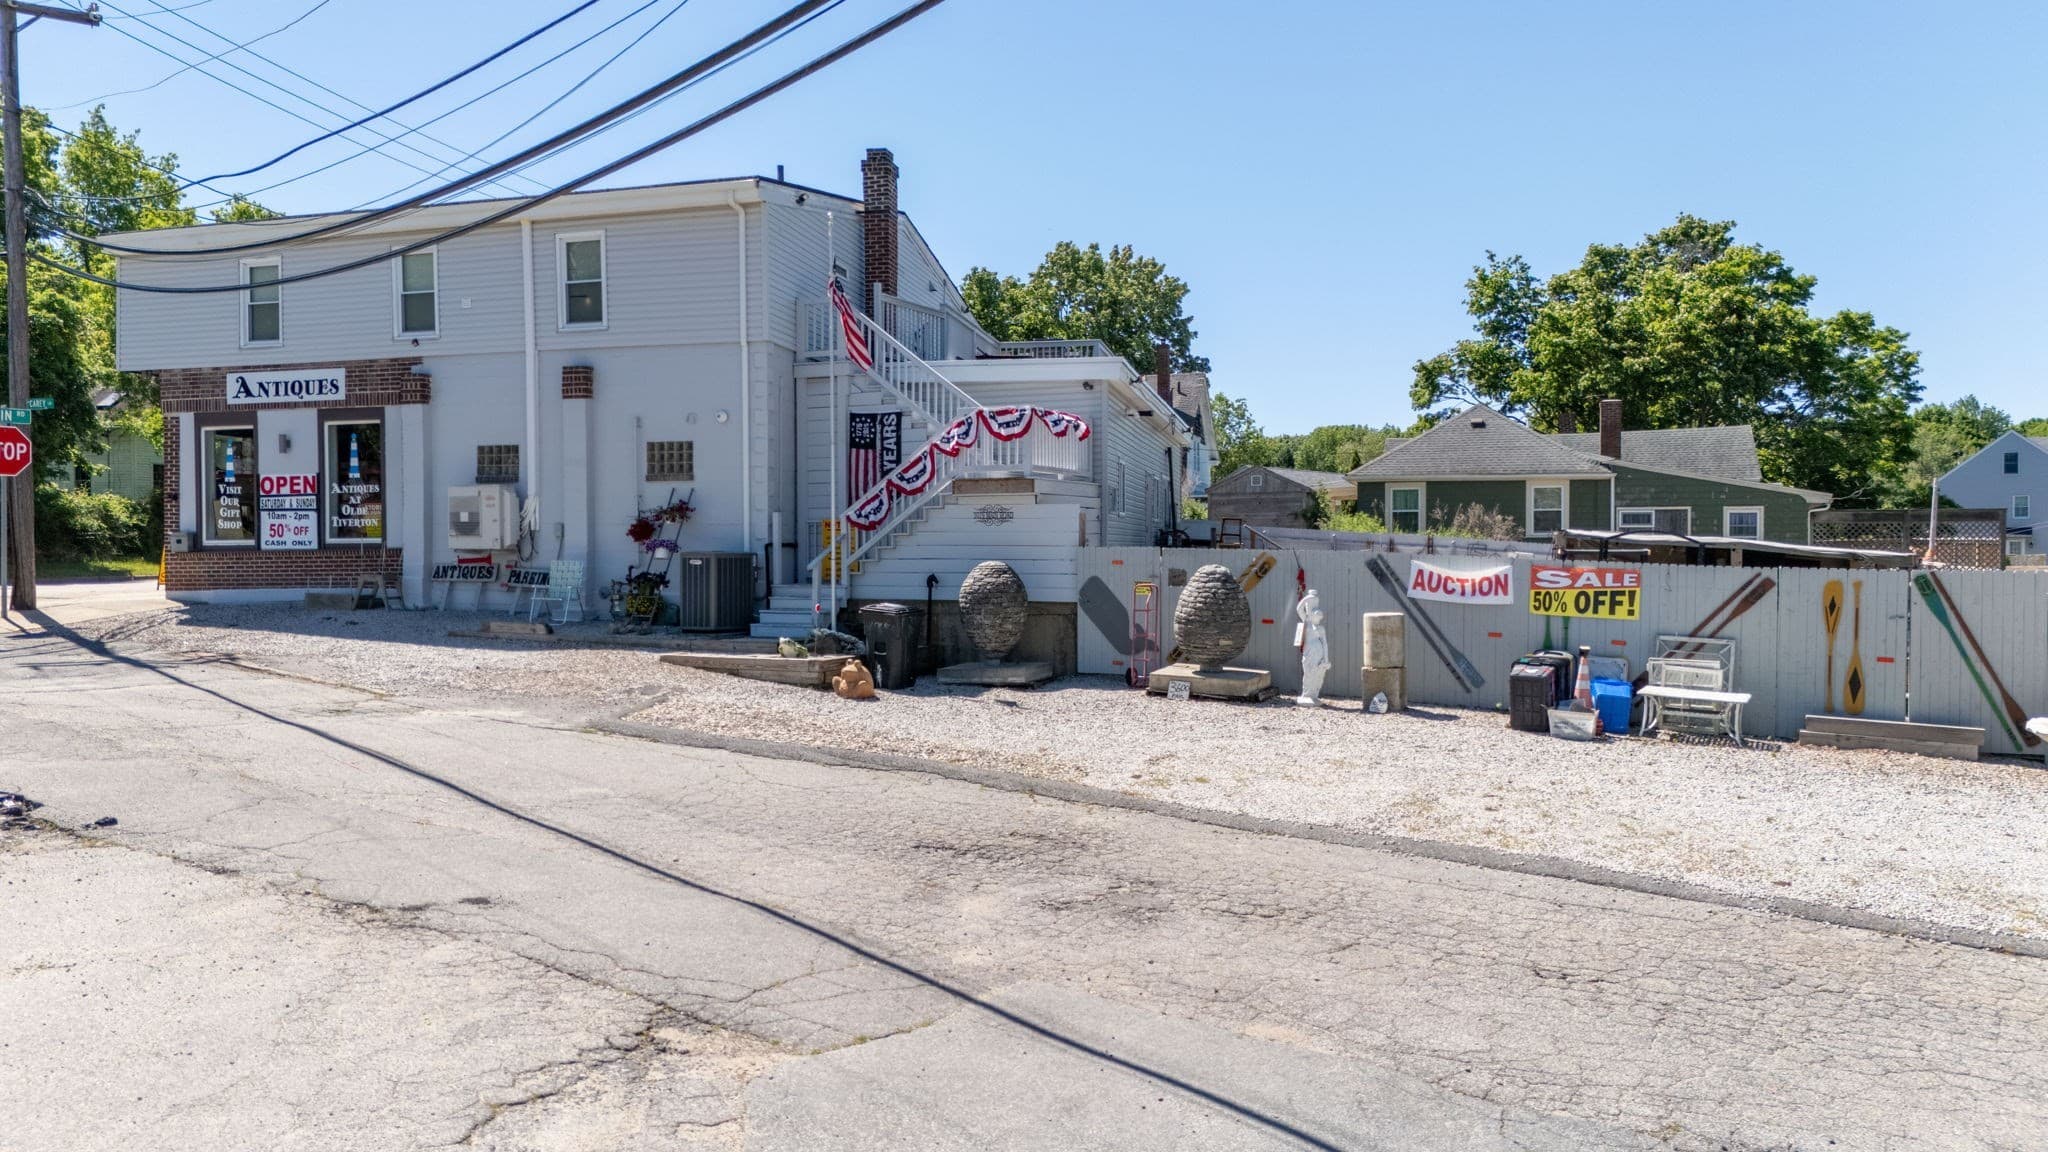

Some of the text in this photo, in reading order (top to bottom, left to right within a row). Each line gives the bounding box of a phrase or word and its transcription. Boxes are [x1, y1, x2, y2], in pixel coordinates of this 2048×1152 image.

[232, 376, 339, 399] ANTIQUES
[0, 409, 12, 421] IN
[883, 413, 897, 472] YEARS
[218, 484, 242, 494] VISIT
[260, 476, 316, 494] OPEN
[331, 482, 380, 494] ANTIQUES
[220, 496, 240, 506] OUR
[349, 496, 361, 504] AT
[220, 508, 240, 518] GIFT
[341, 504, 368, 516] OLDE
[268, 512, 287, 520] 10am
[294, 512, 309, 521] 2pm
[331, 516, 378, 527] TIVERTON
[217, 519, 242, 529] SHOP
[269, 523, 309, 538] 50% OFF
[432, 564, 494, 580] ANTIQUES
[1412, 569, 1508, 597] AUCTION
[1535, 569, 1638, 588] SALE
[1533, 590, 1635, 617] 50% OFF!
